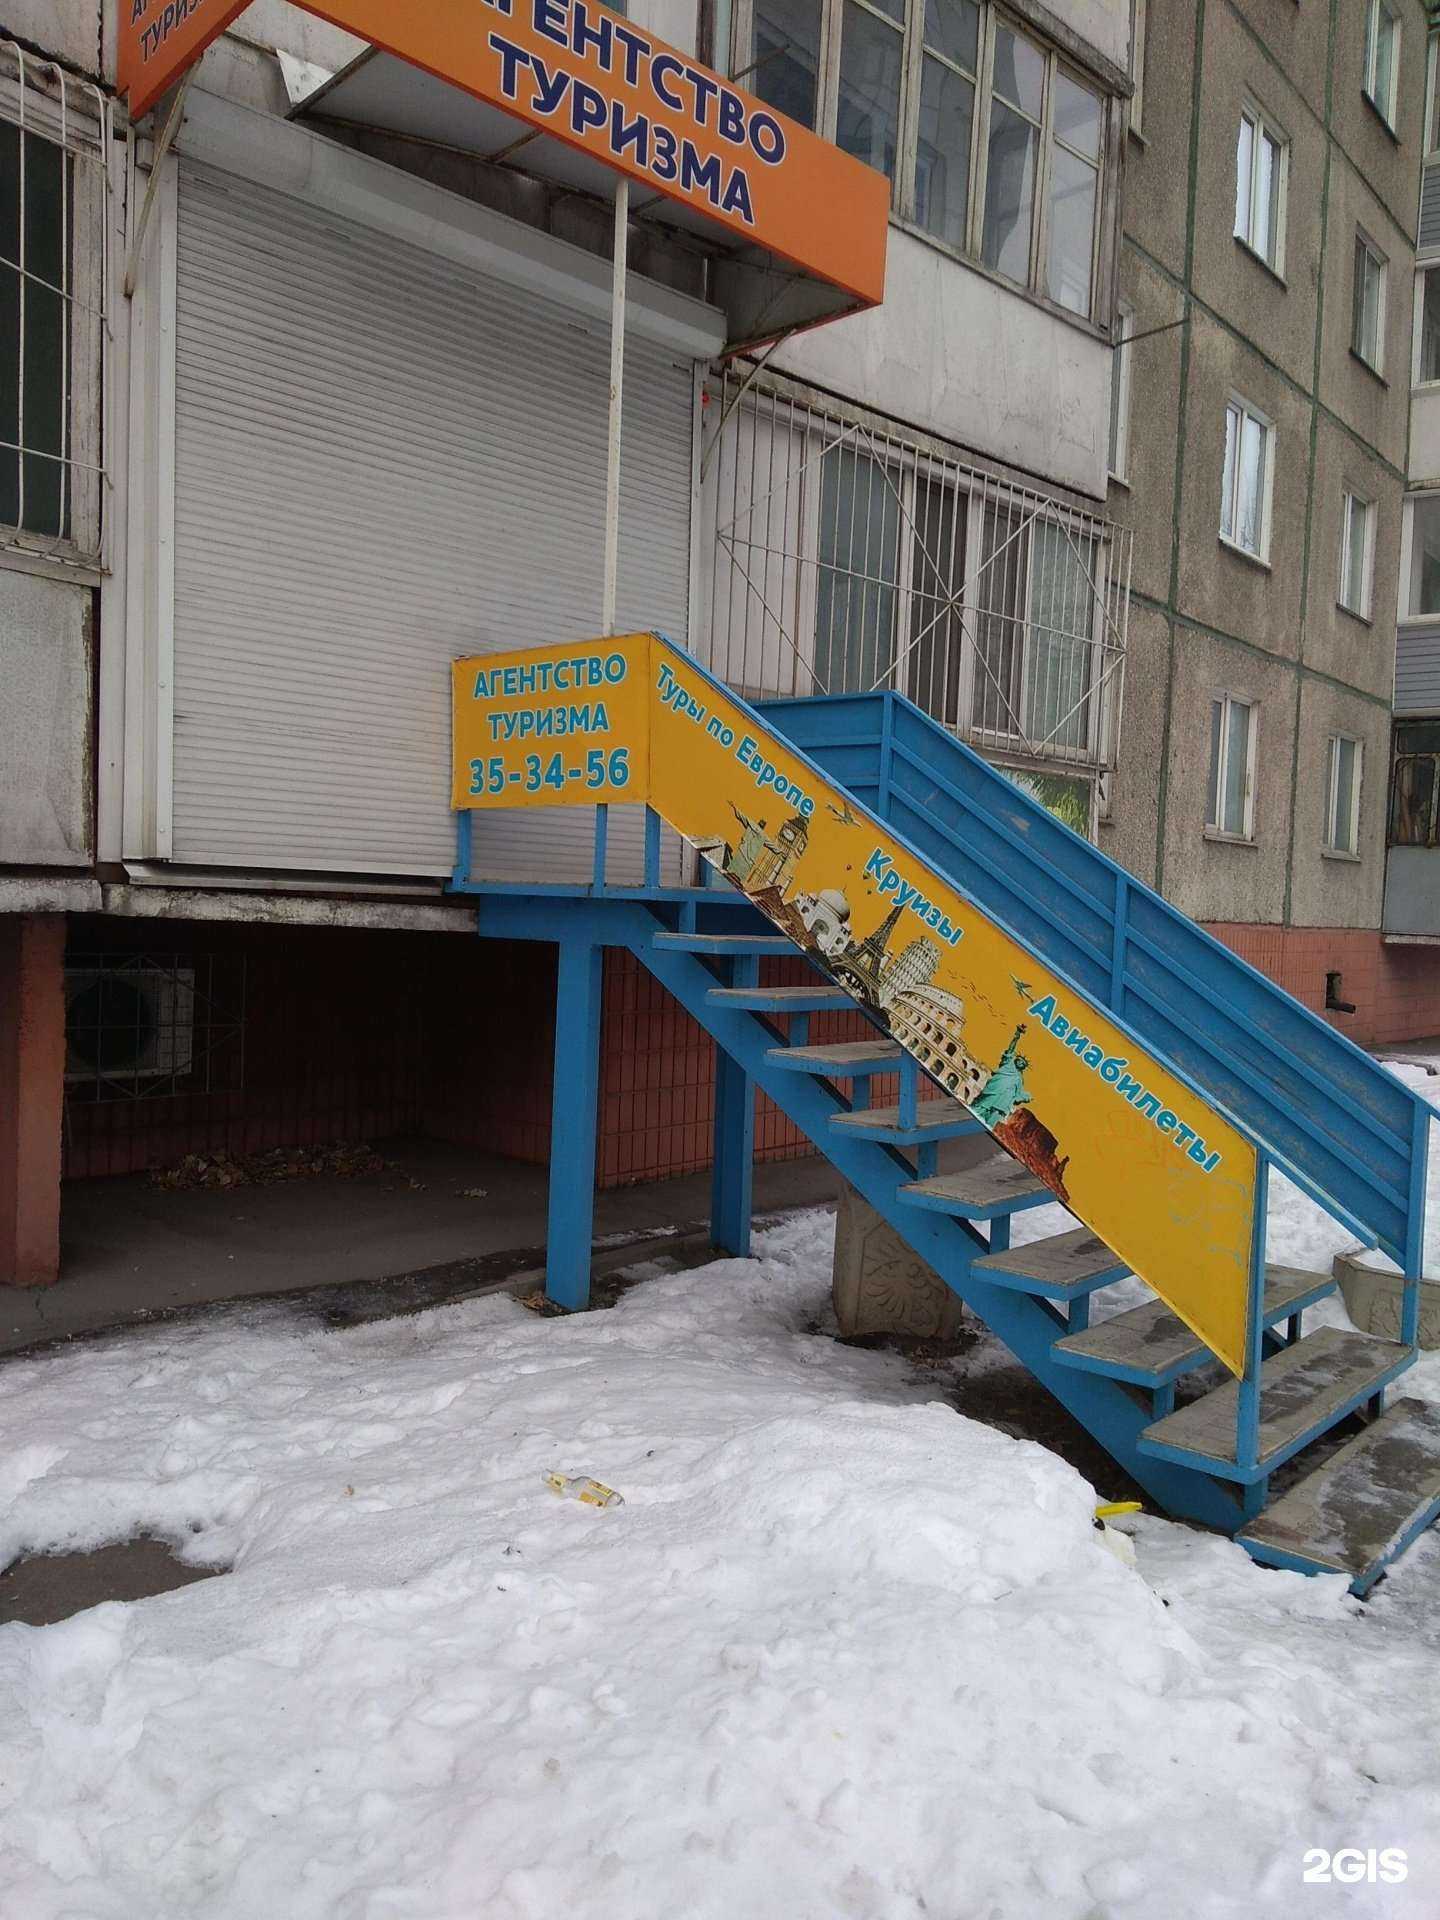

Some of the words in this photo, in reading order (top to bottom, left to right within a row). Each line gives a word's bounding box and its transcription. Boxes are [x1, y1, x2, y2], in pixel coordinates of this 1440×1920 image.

[481, 0, 786, 166] ЕНТСТВО
[488, 31, 754, 225] ТУРИЗМА
[473, 652, 627, 698] АГЕНТСТВО
[488, 702, 609, 740] ТУРИЗМА
[469, 747, 630, 795] 35-34-56
[656, 663, 706, 724] Туры
[706, 715, 735, 748] по
[734, 735, 815, 818] Европе
[863, 847, 963, 946] Круизы
[1028, 994, 1222, 1174] Авиабилеты
